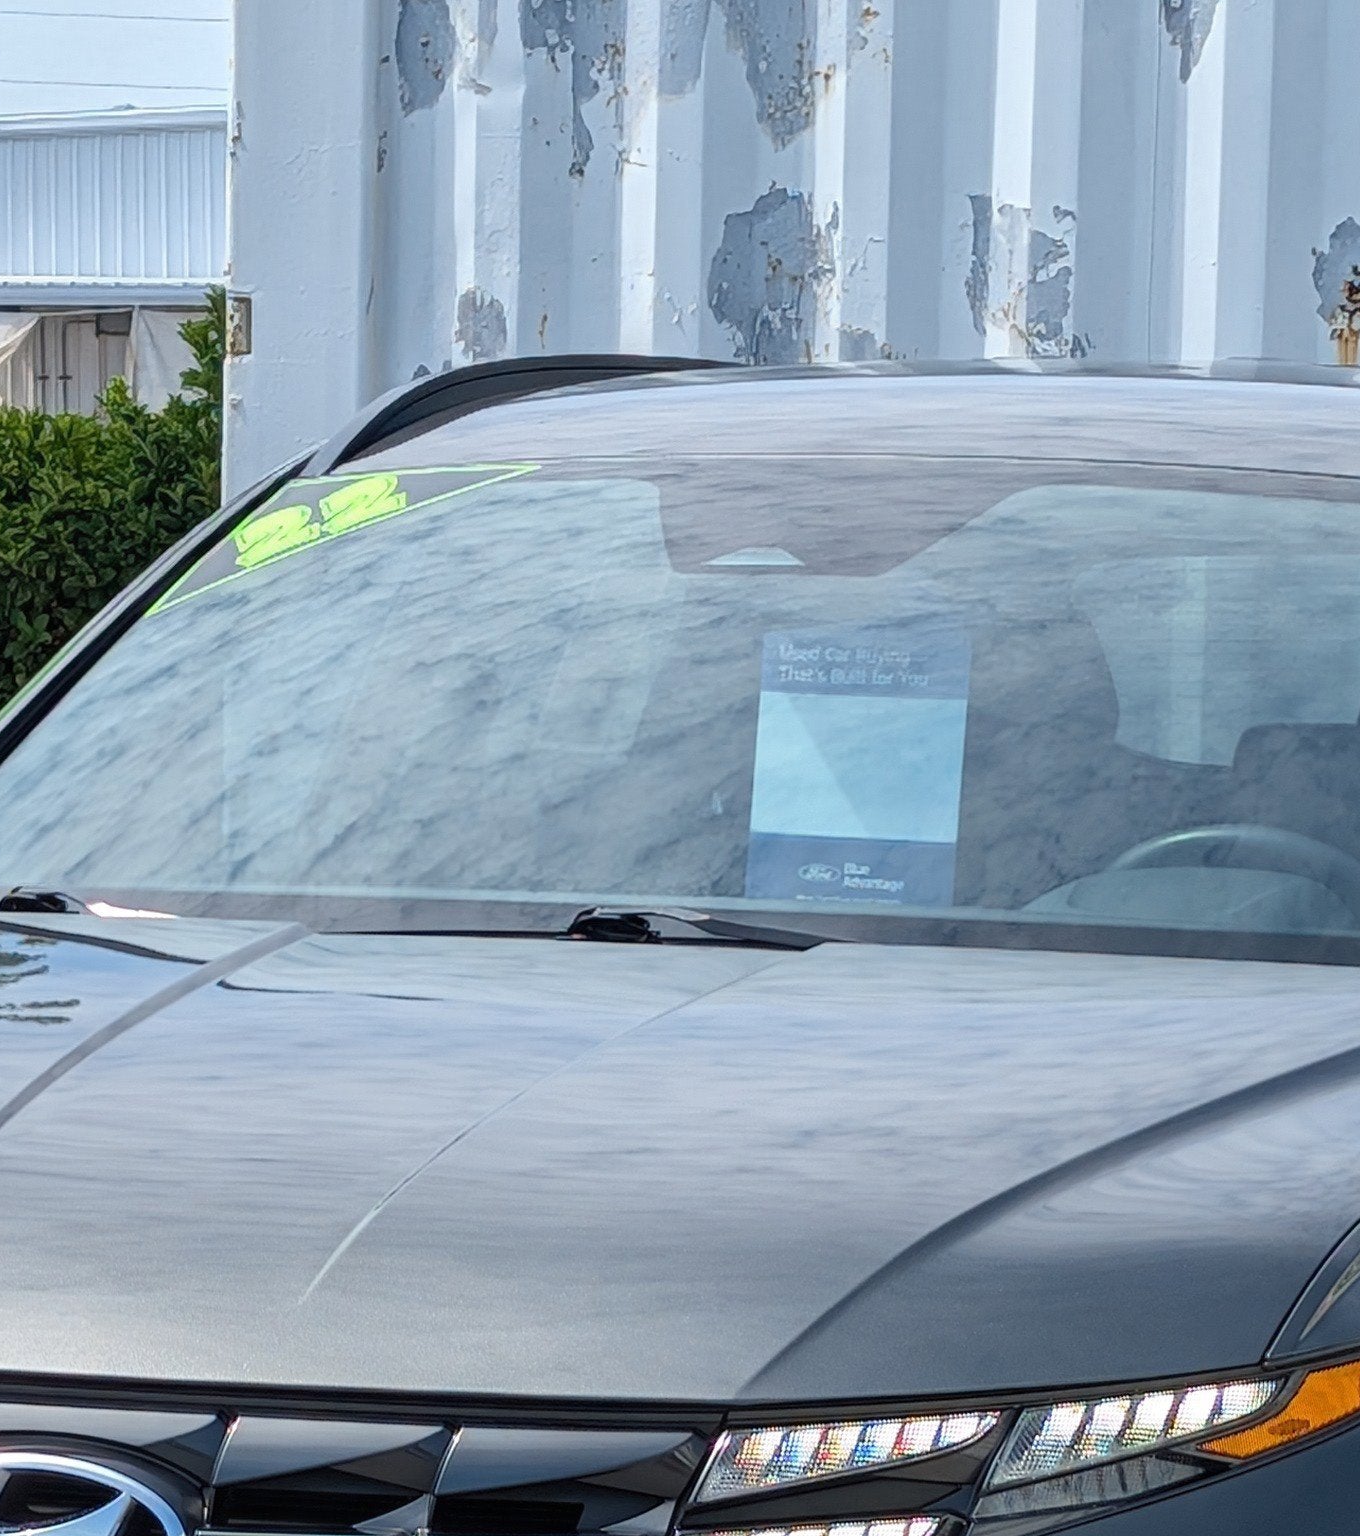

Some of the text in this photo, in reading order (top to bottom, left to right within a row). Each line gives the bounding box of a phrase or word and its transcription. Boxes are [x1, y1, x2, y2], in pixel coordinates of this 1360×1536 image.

[234, 474, 407, 568] 22
[778, 643, 821, 662] Used
[843, 863, 871, 875] Blue
